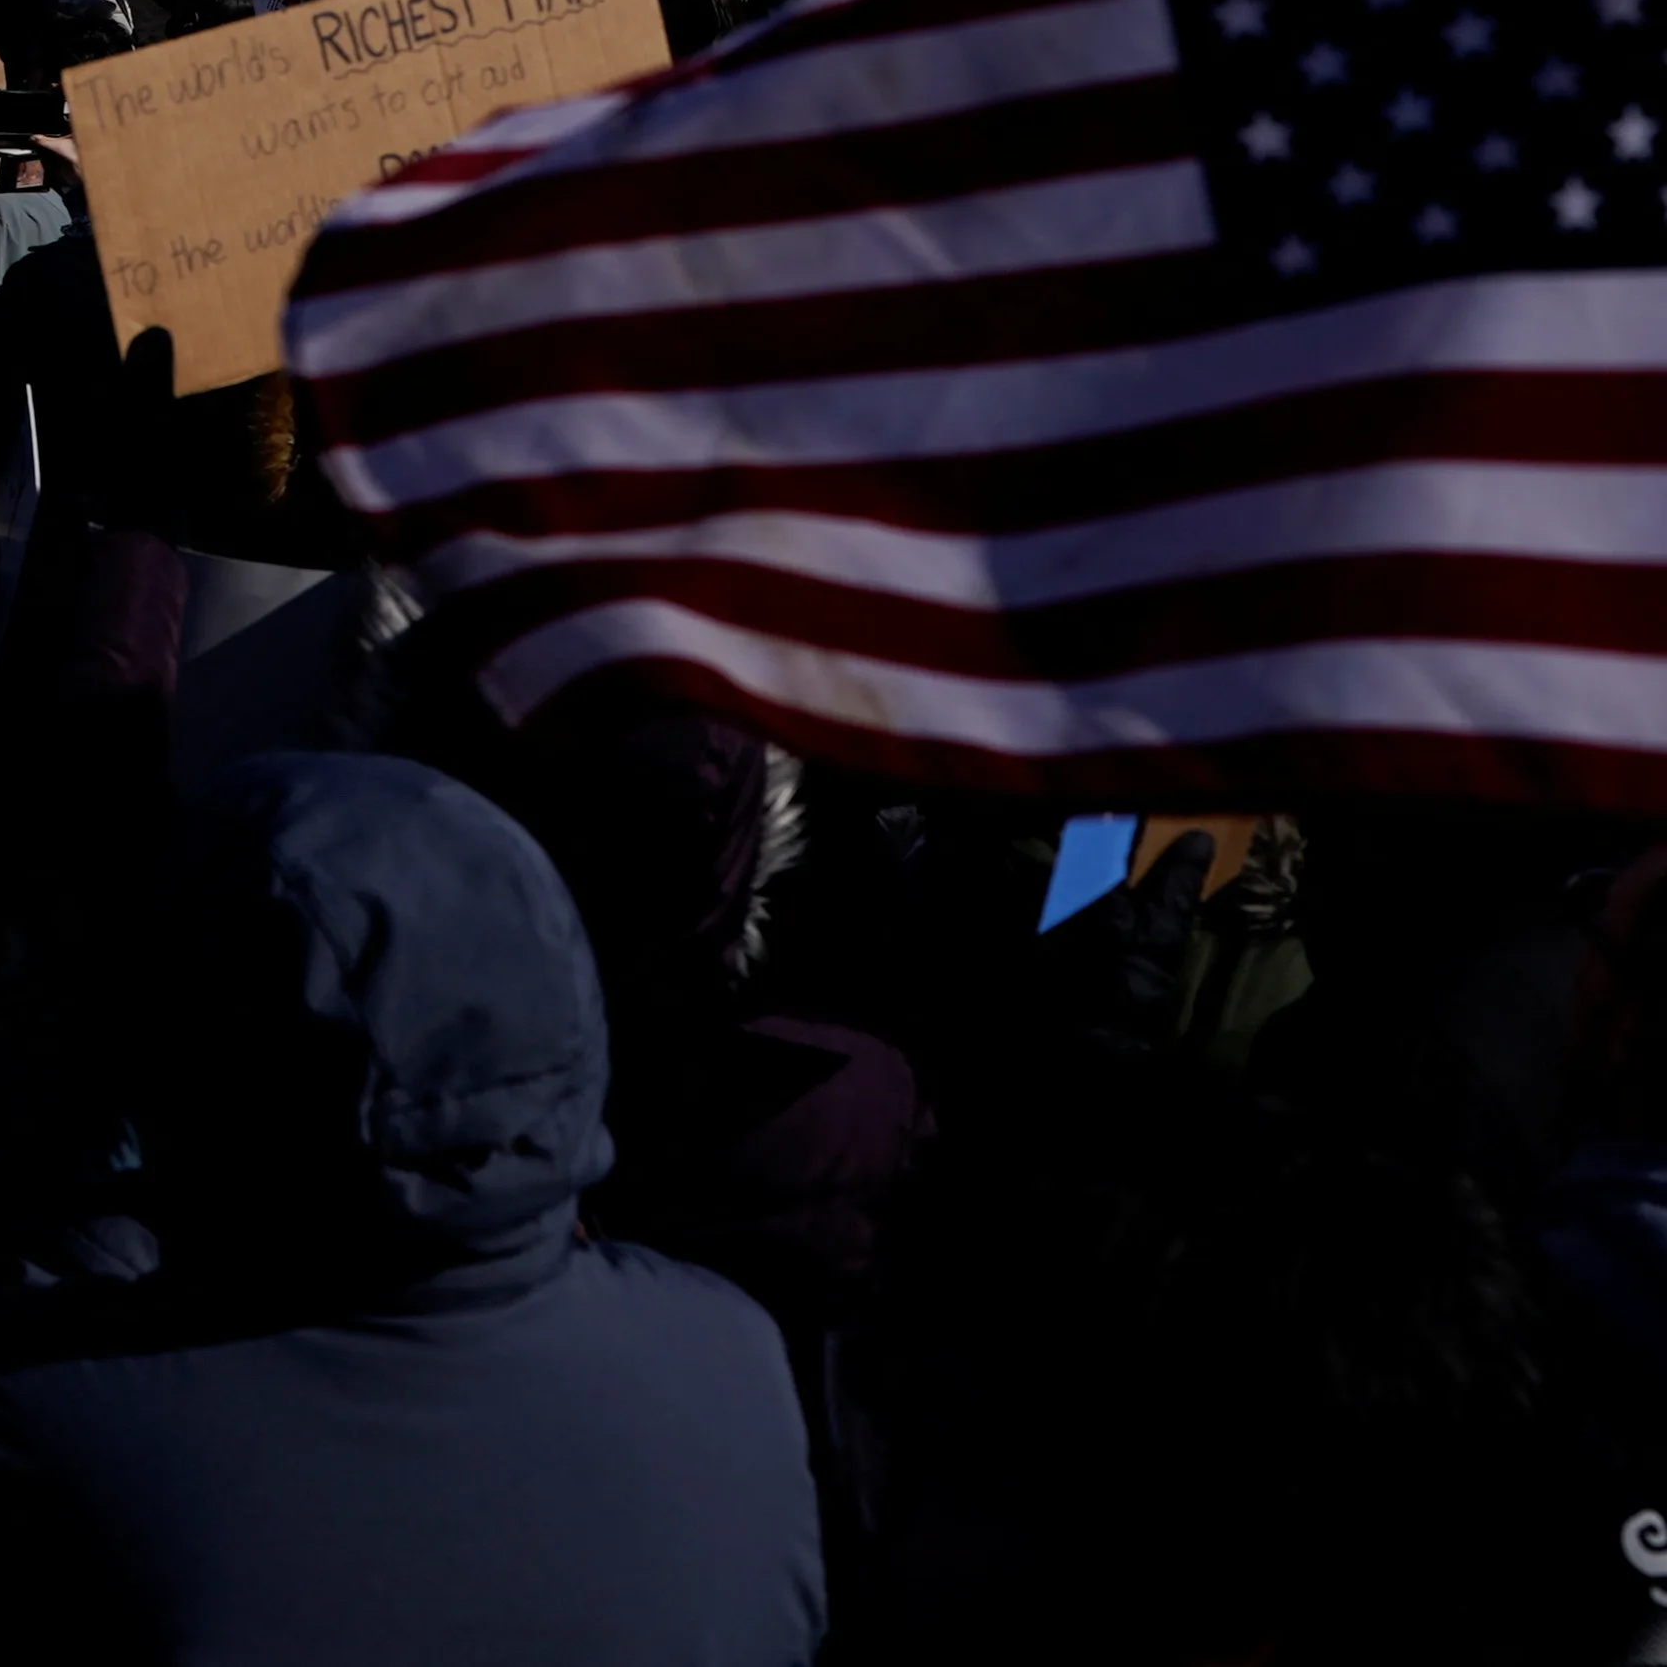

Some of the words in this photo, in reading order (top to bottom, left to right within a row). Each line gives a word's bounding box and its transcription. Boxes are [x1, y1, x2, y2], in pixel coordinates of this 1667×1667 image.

[73, 74, 156, 132] The
[169, 37, 292, 108] world's
[243, 94, 361, 162] wants
[374, 77, 407, 116] to
[481, 47, 526, 94] aid
[112, 258, 161, 302] to
[170, 227, 227, 282] the
